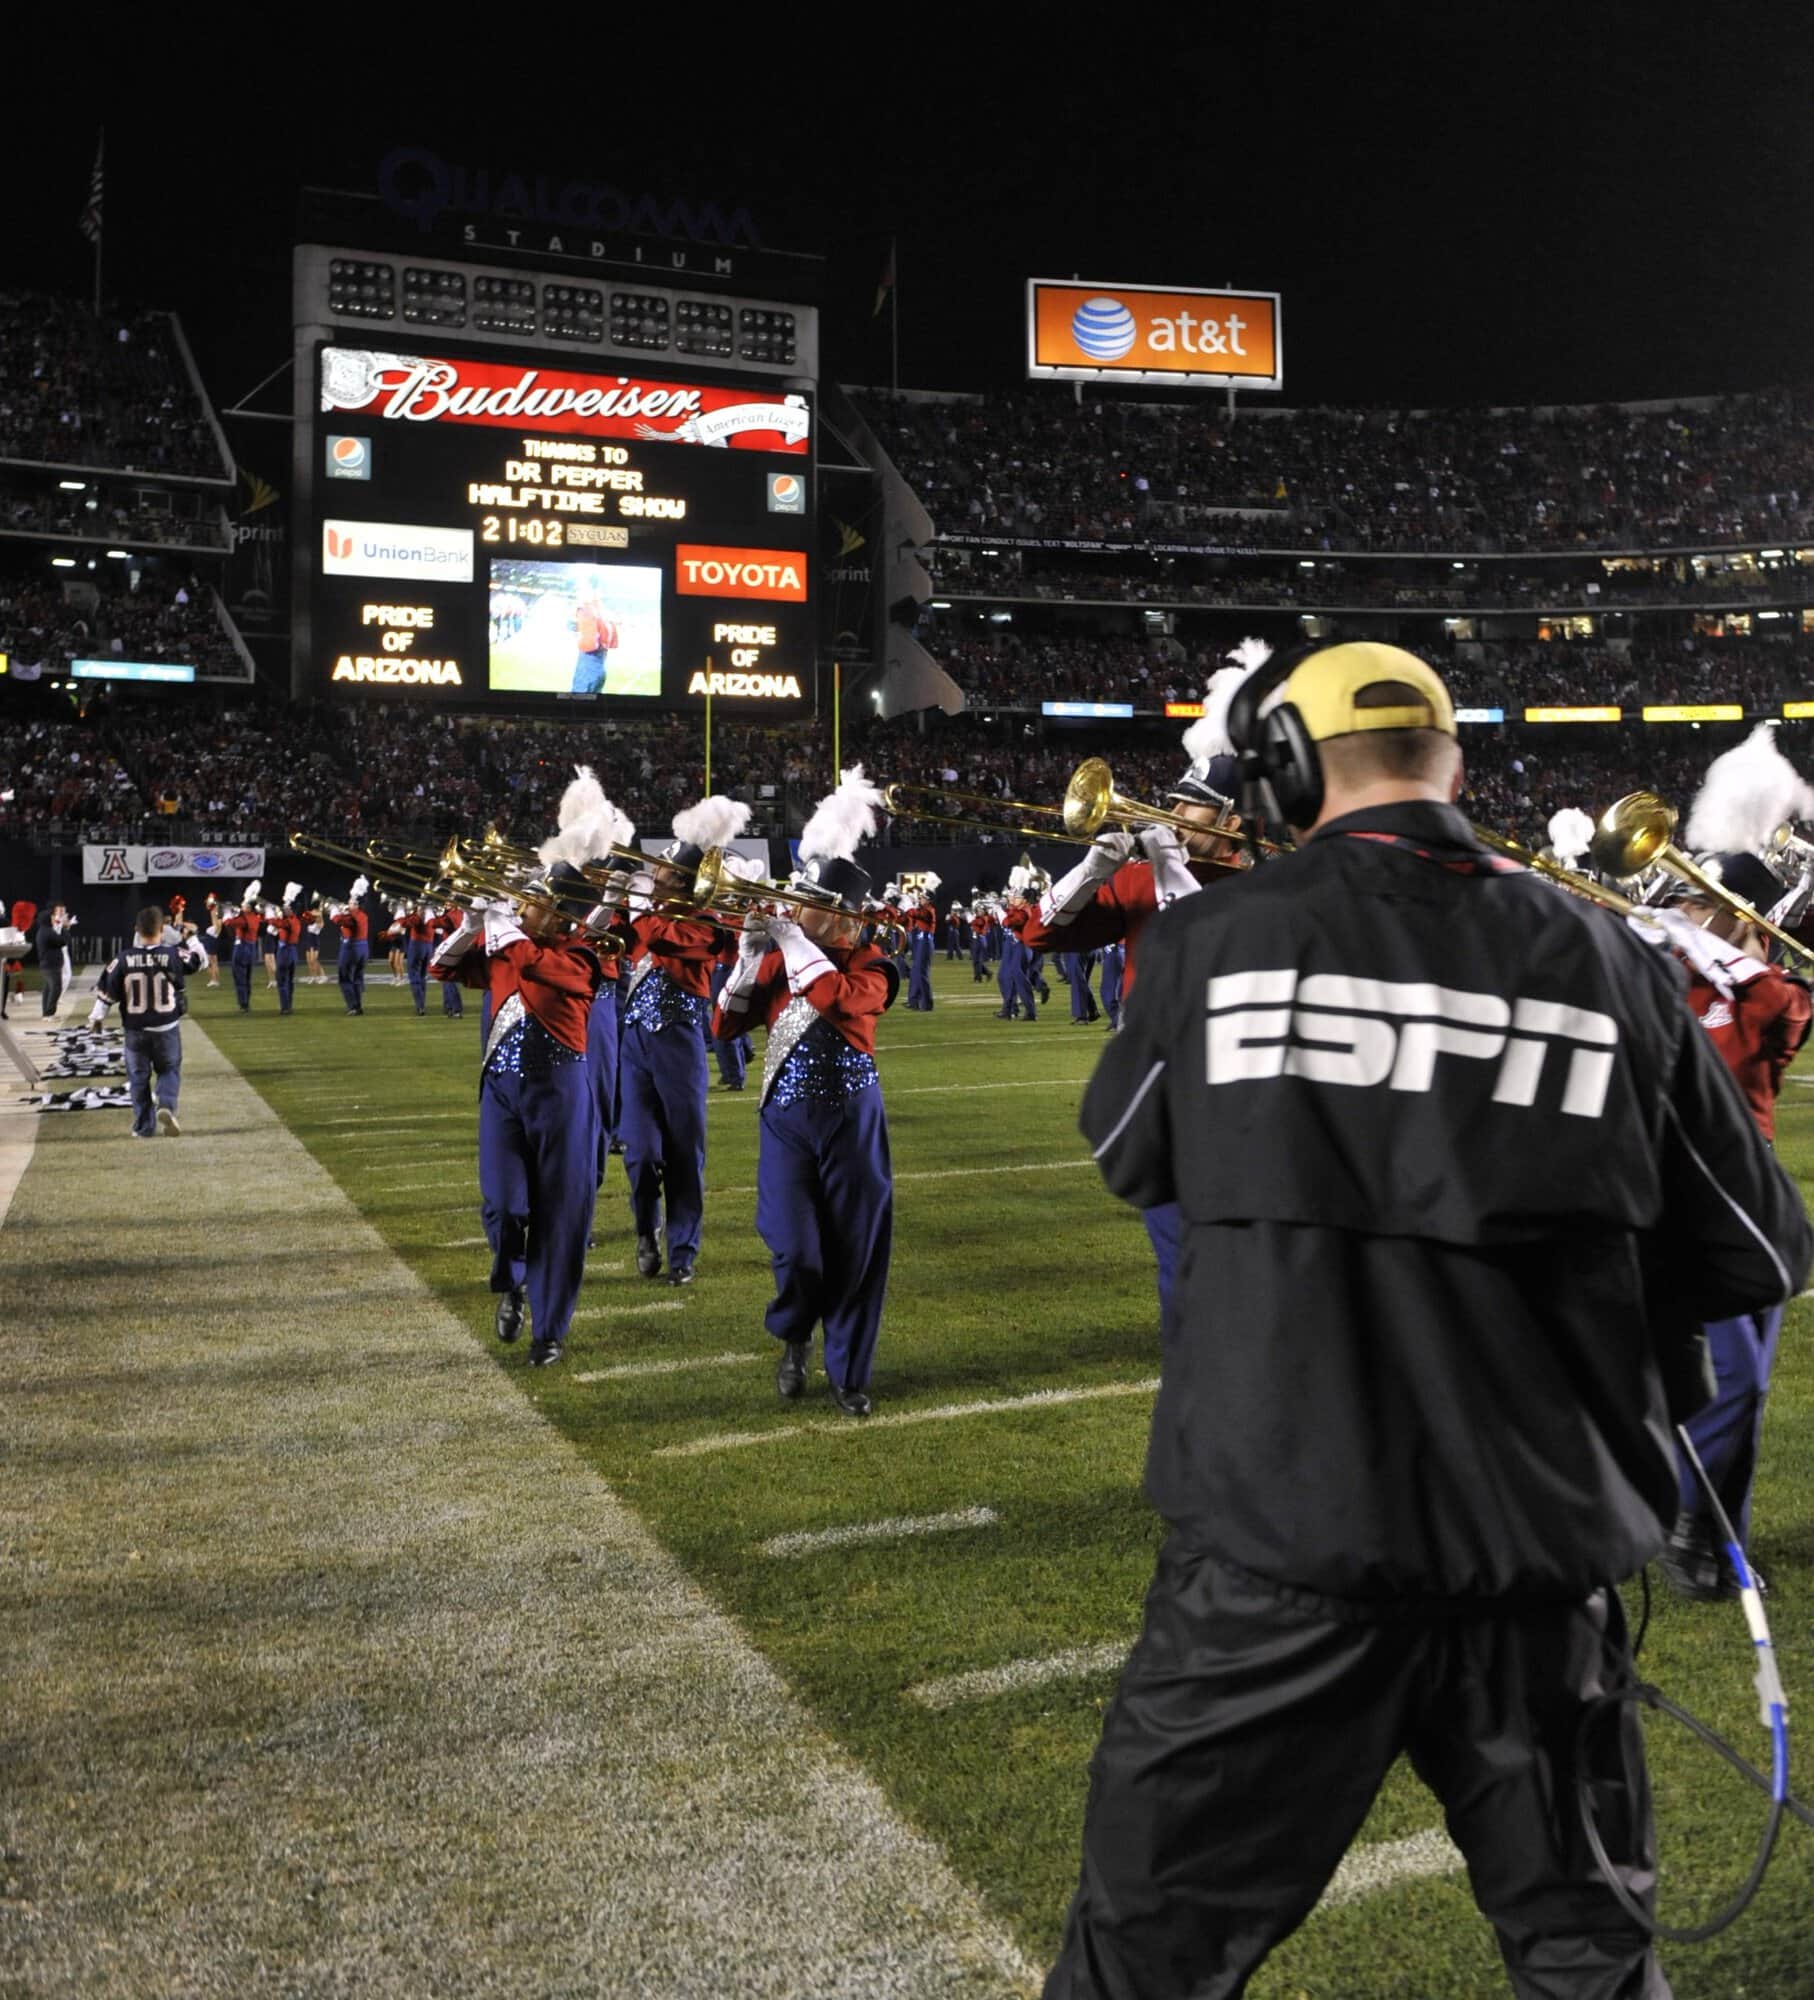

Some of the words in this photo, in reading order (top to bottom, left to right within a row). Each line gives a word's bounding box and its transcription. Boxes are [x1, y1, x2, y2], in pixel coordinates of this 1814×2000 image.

[464, 225, 732, 272] STADIUM
[1148, 311, 1247, 356] at&t
[368, 364, 702, 421] Budweiser
[705, 411, 765, 435] American
[523, 439, 596, 462] THANKS
[601, 446, 628, 465] TO
[505, 460, 542, 483] DR
[551, 464, 644, 491] PEPPER
[469, 483, 605, 514] HALFTIME
[619, 496, 686, 519] SHOW
[683, 560, 801, 589] TOYOTA
[362, 604, 434, 628] PRIDE
[382, 632, 415, 652] OF
[714, 623, 776, 645] PRIDE
[332, 656, 463, 685] ARIZONA
[731, 649, 760, 667] OF
[688, 671, 802, 698] ARIZONA
[124, 970, 177, 1014] 00
[1206, 968, 1619, 1119] ESPN
